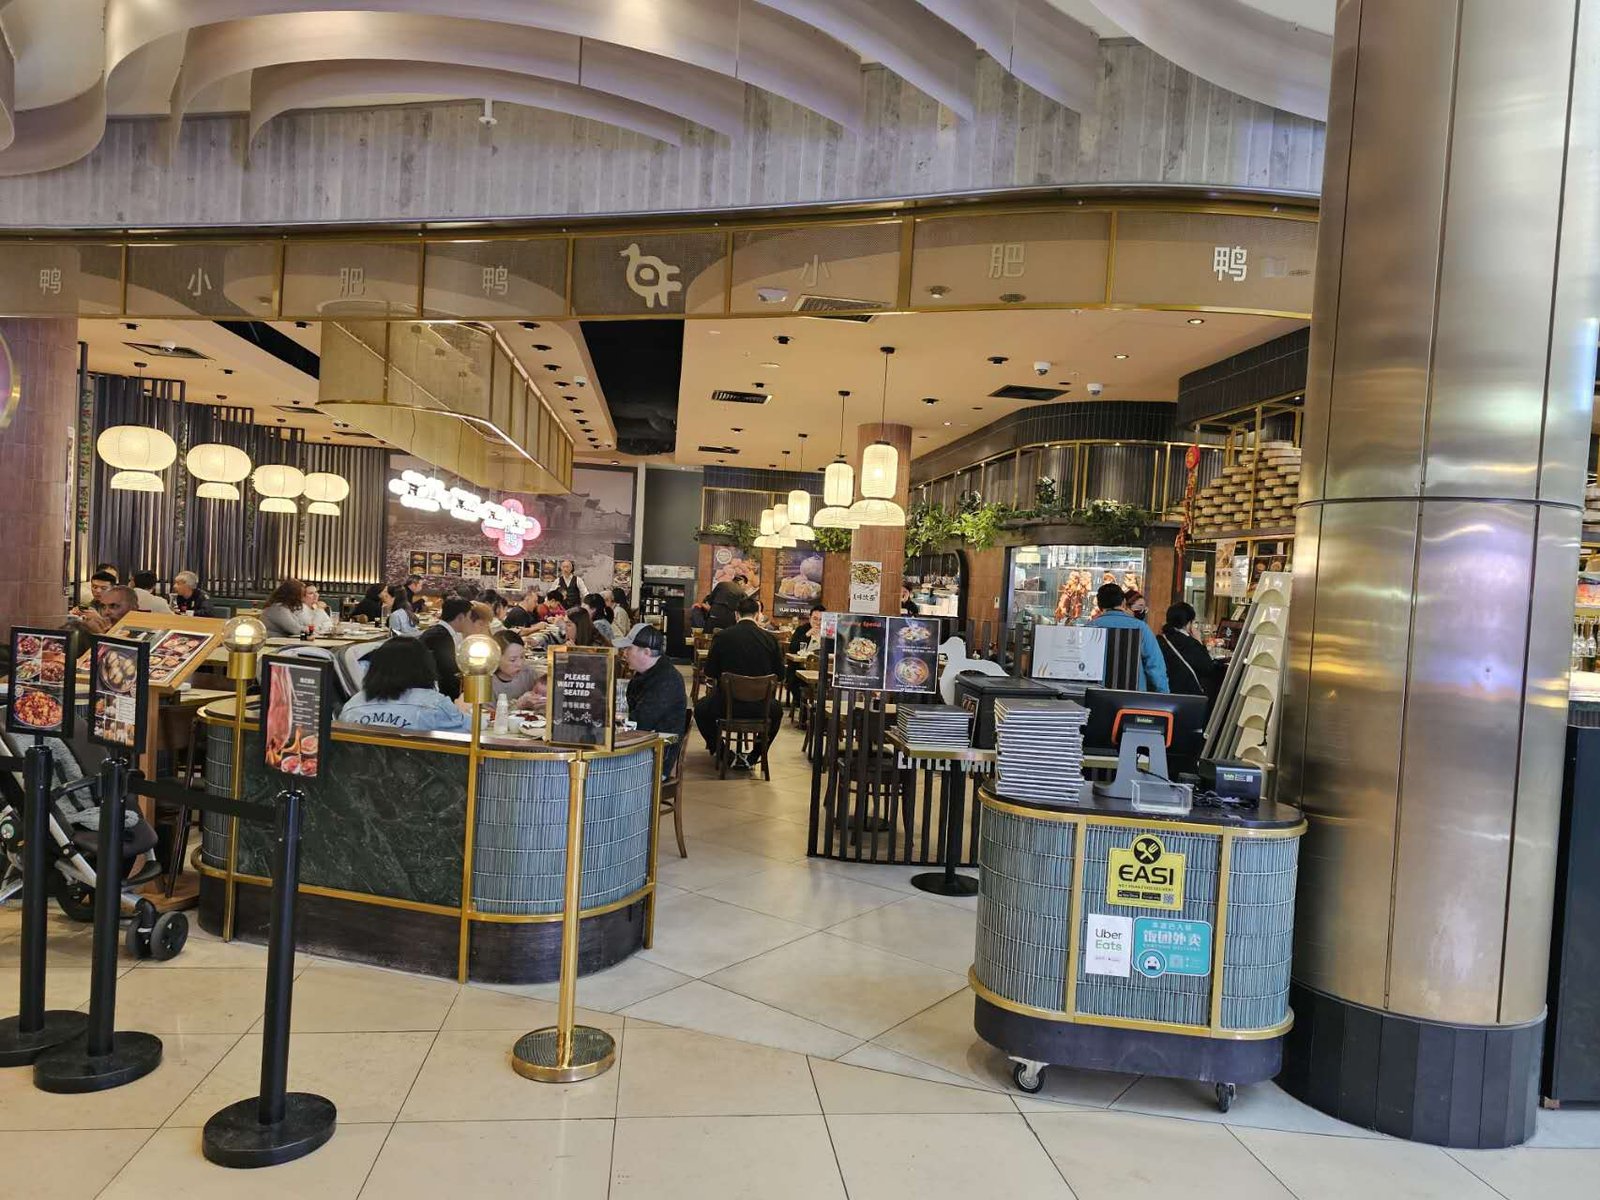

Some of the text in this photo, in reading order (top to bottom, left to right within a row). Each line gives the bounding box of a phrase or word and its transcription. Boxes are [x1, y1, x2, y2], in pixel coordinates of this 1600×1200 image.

[800, 243, 1247, 288] 小 肥 鸭
[40, 267, 61, 295] 鸭
[187, 265, 508, 297] 小 肥 鸭
[354, 712, 411, 729] OMMY
[1118, 864, 1175, 886] EASI
[1096, 928, 1122, 940] Uber
[1095, 940, 1122, 951] Eats
